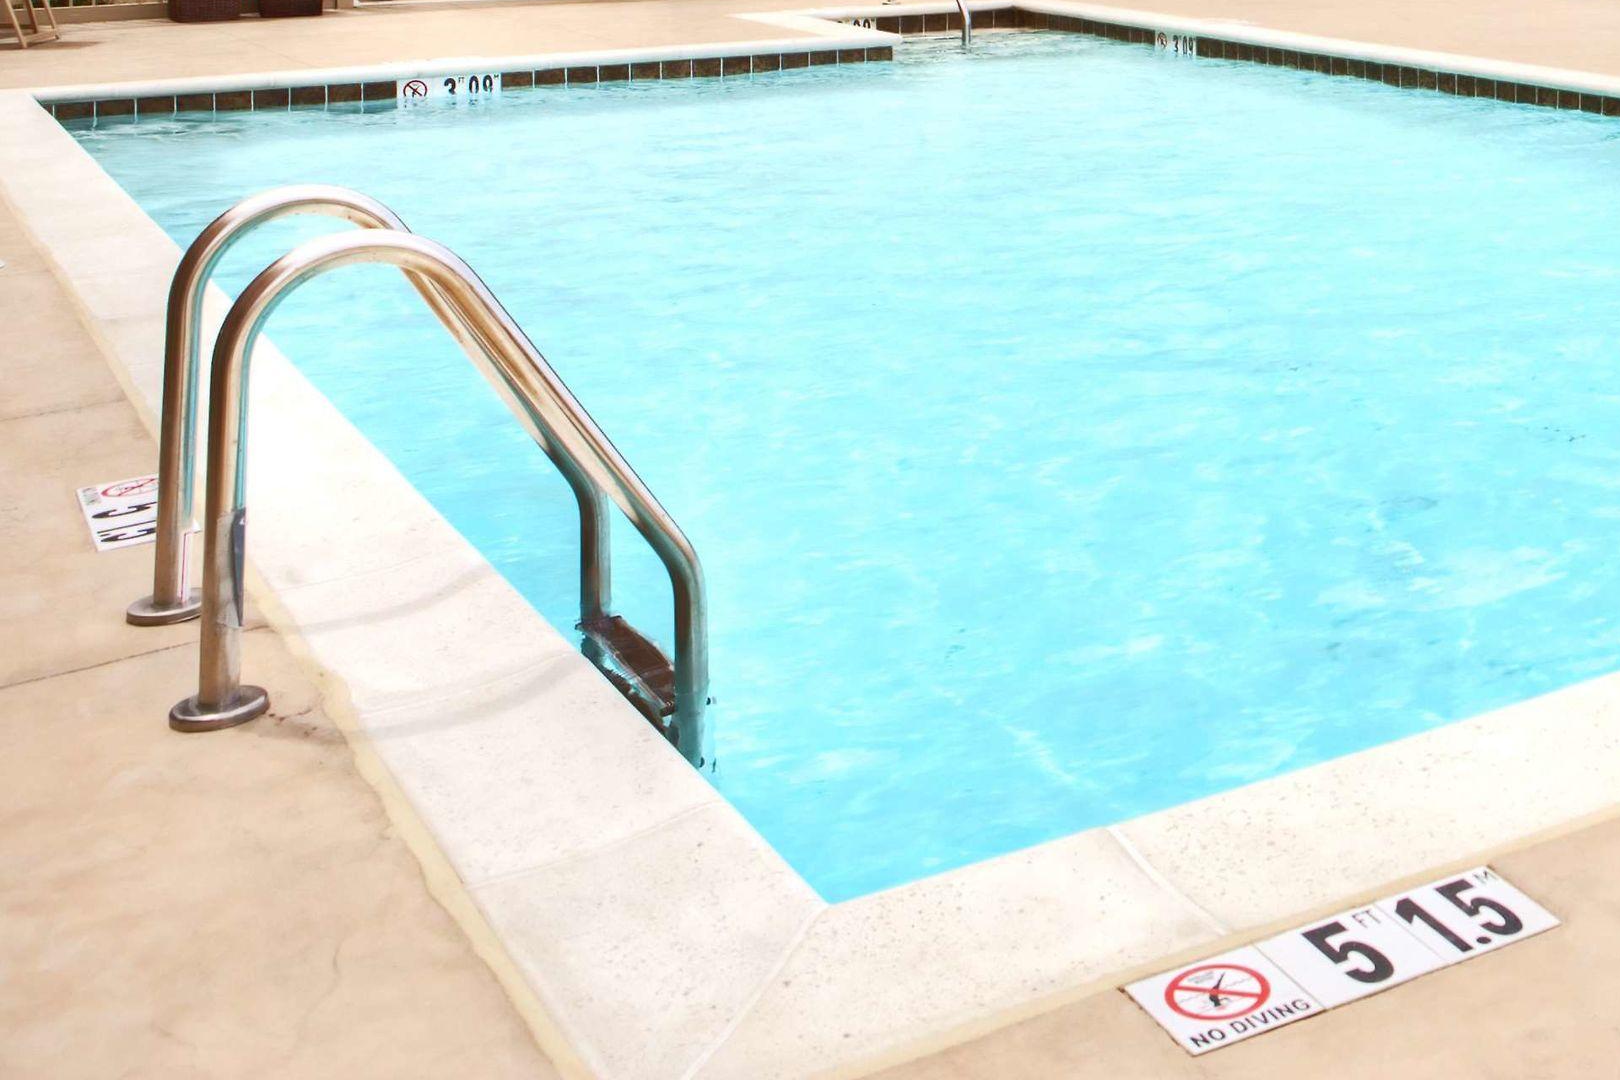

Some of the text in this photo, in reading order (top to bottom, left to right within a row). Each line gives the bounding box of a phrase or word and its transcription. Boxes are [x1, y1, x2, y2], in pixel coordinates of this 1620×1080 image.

[1301, 921, 1395, 983] 5
[1395, 878, 1524, 953] 1.5
[1189, 998, 1311, 1048] NO DIVING
